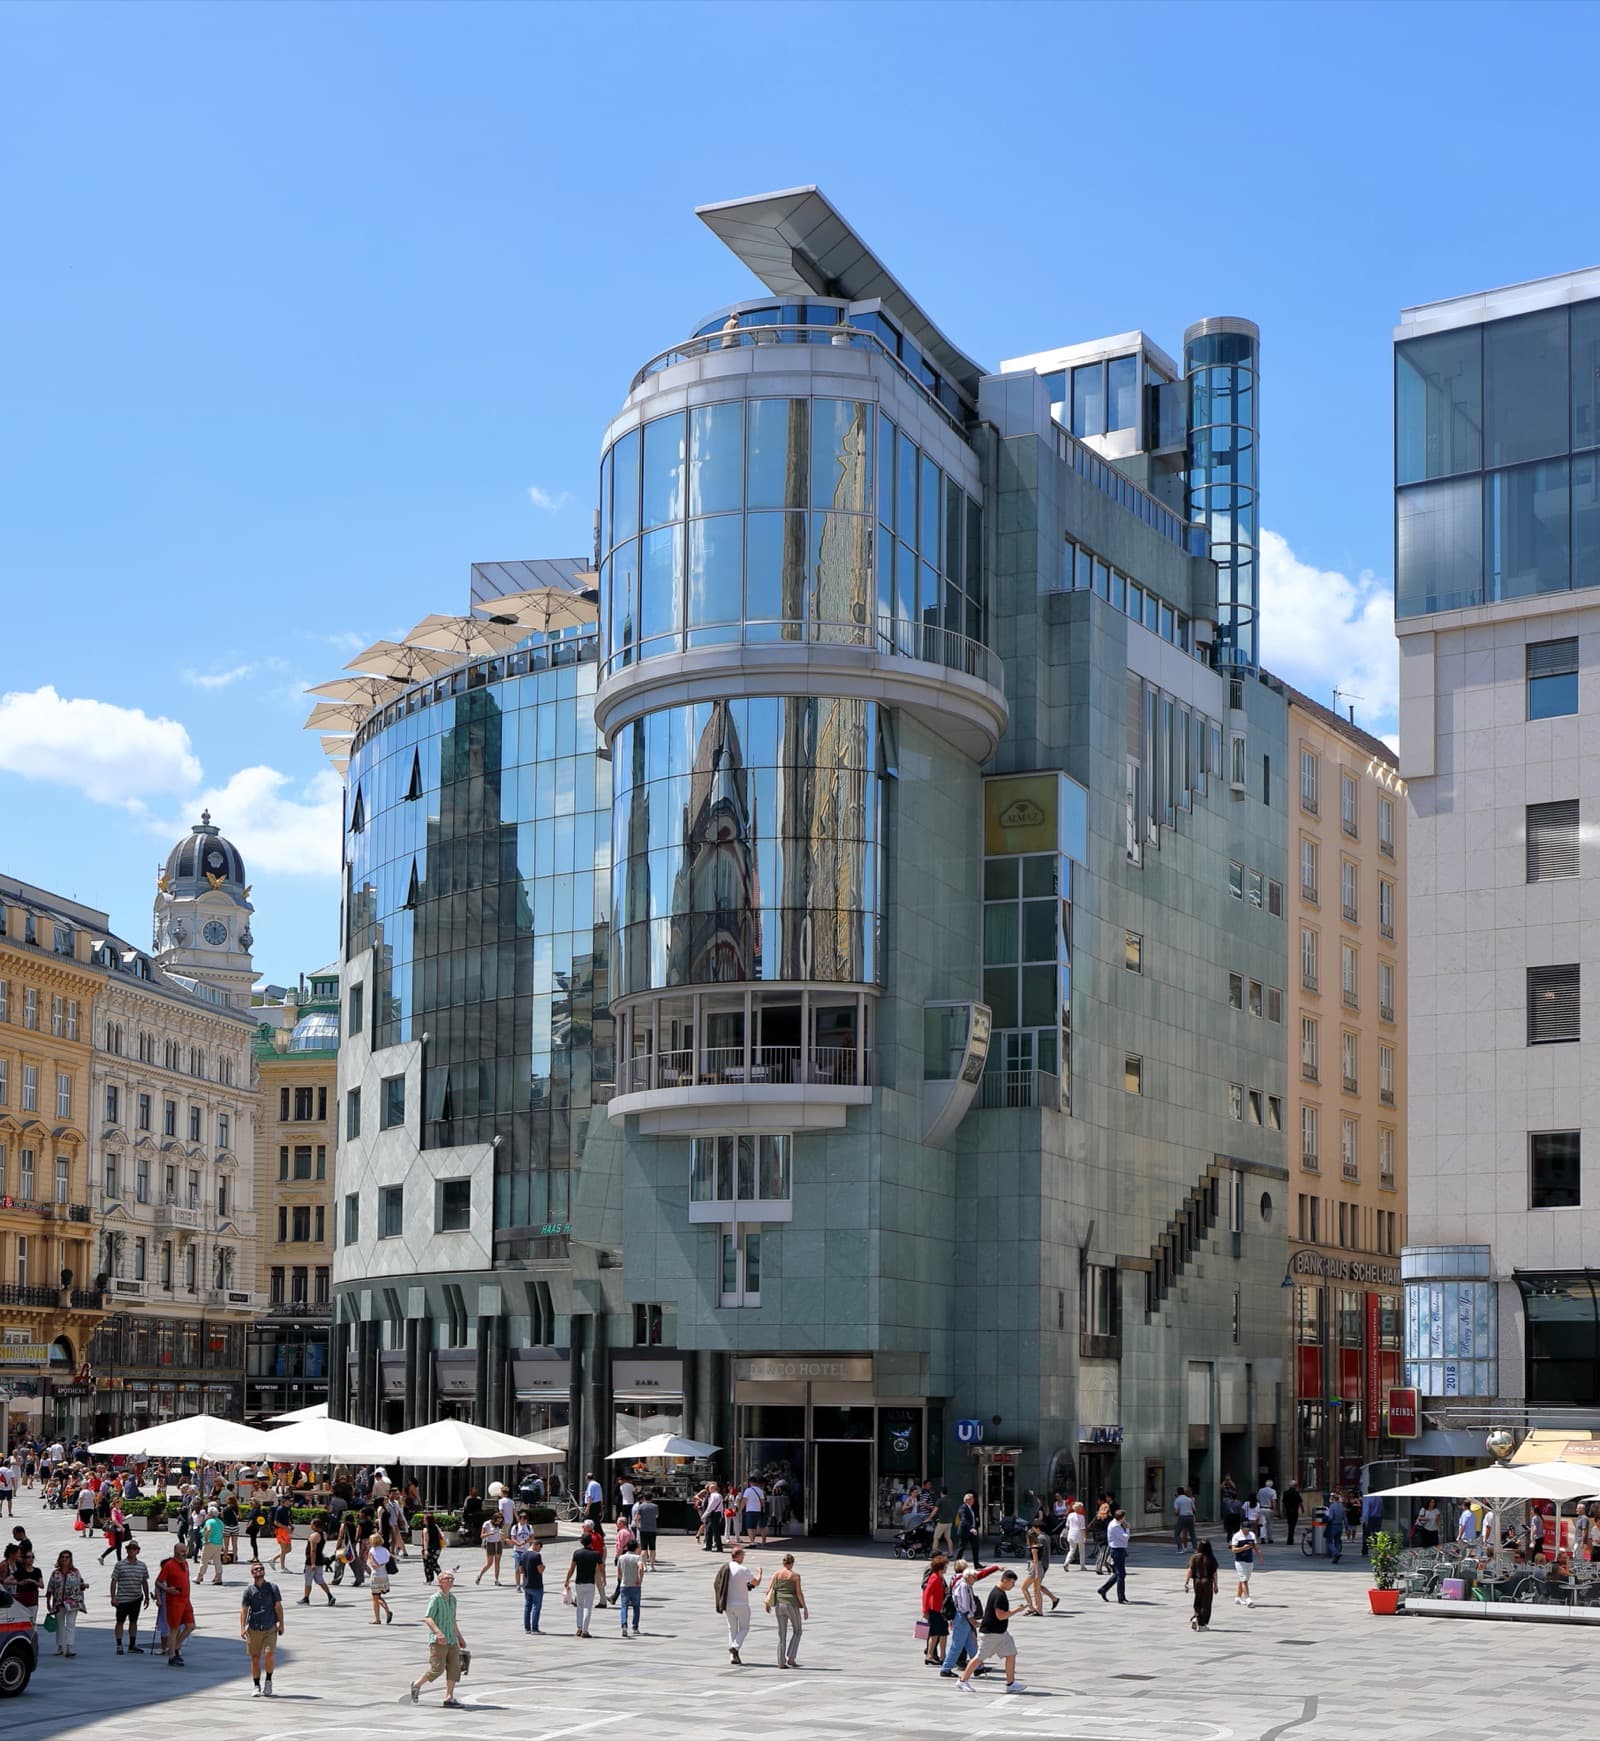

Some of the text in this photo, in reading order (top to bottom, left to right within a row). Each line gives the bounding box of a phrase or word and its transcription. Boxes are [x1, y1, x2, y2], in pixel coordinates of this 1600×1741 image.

[1008, 812, 1039, 823] ALMAZ
[541, 1223, 561, 1234] HAAS
[1297, 1255, 1348, 1279] BANKHAUS
[800, 1363, 846, 1376] HOTEL
[1447, 1366, 1455, 1389] 2018
[57, 1387, 86, 1395] APOTHEKE
[1390, 1408, 1414, 1417] HEINDL
[958, 1424, 973, 1441] U
[976, 1424, 984, 1441] U
